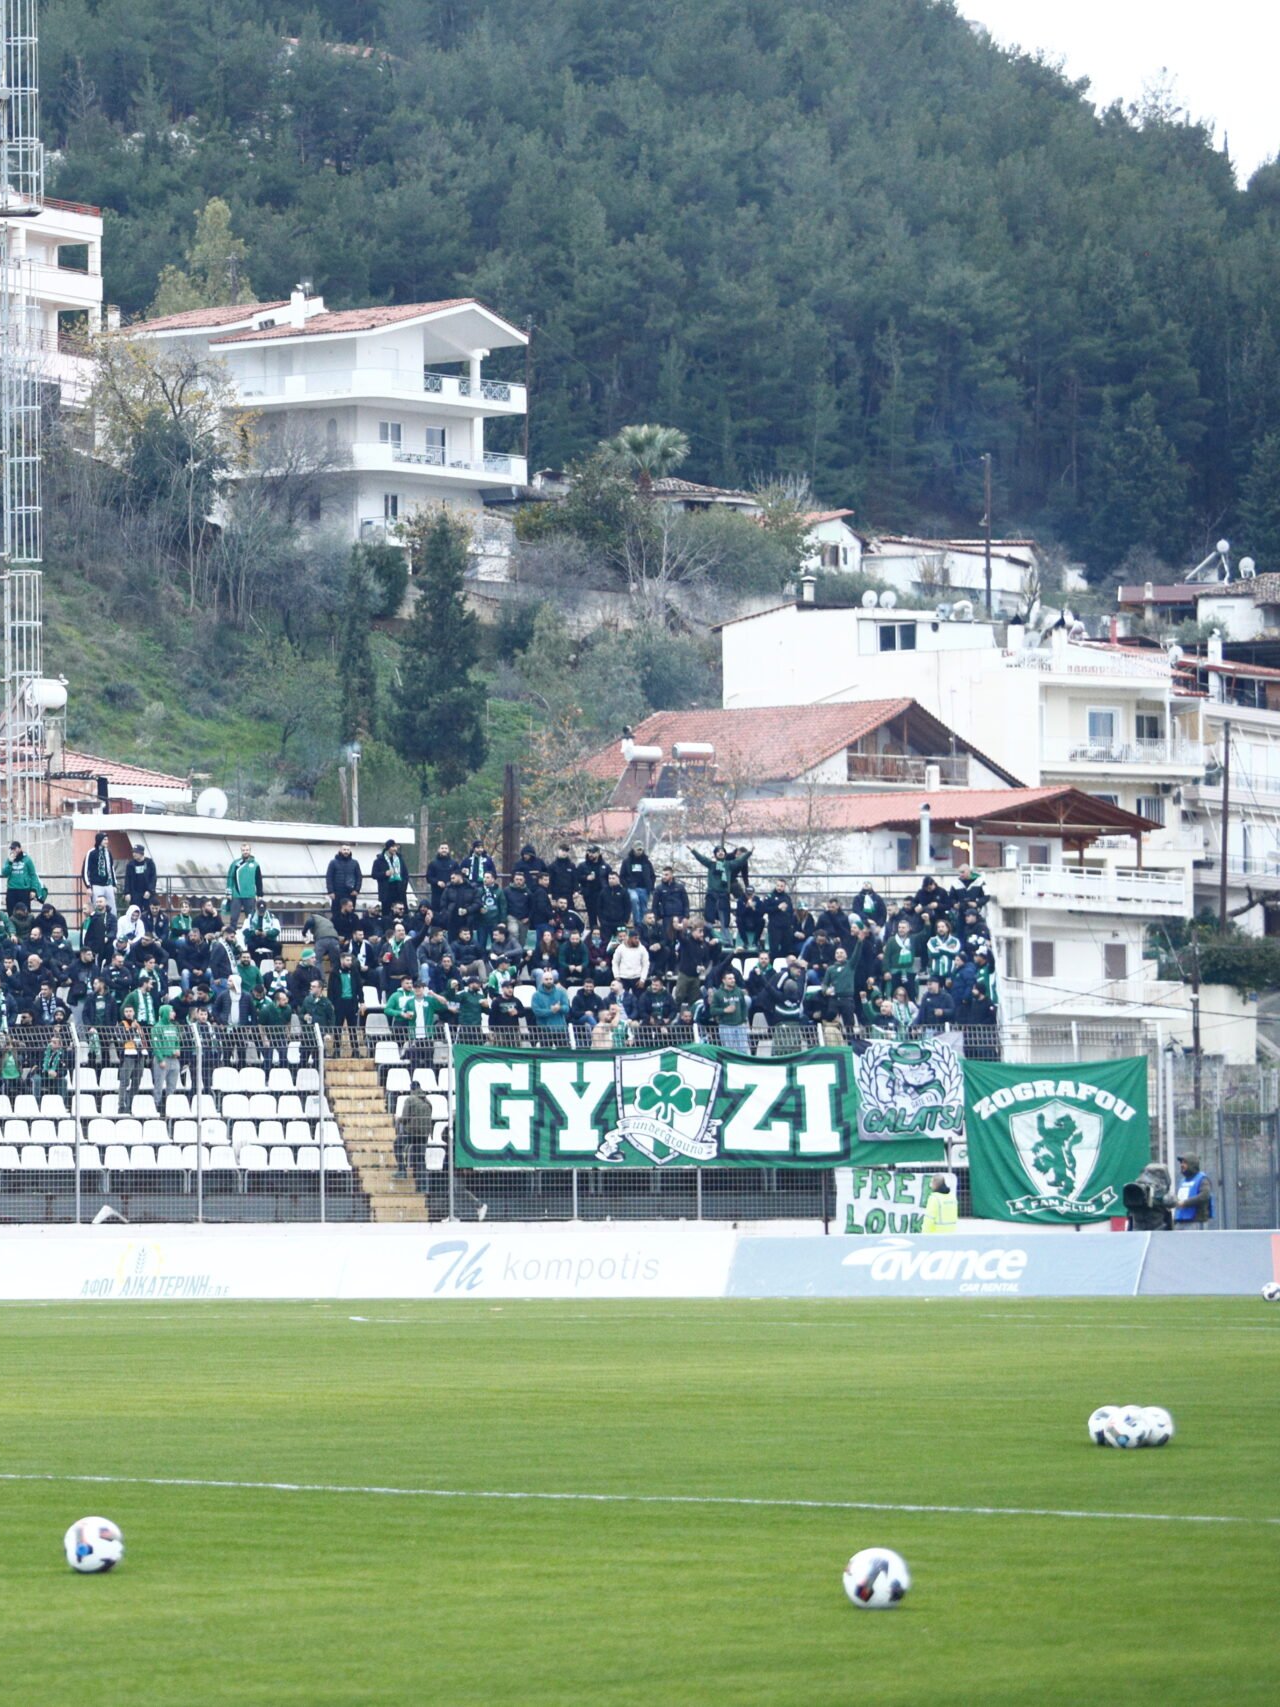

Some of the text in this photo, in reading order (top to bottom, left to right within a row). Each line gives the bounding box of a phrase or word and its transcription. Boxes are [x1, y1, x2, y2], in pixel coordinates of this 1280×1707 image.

[973, 1080, 1136, 1121] ZOGRAFOU
[863, 1105, 964, 1133] GALATSI
[632, 1120, 704, 1156] underground
[1030, 1199, 1097, 1212] FAN CLUB
[503, 1251, 661, 1288] kompotis
[870, 1248, 1028, 1281] avance
[959, 1282, 1019, 1292] CAR RENTAL
